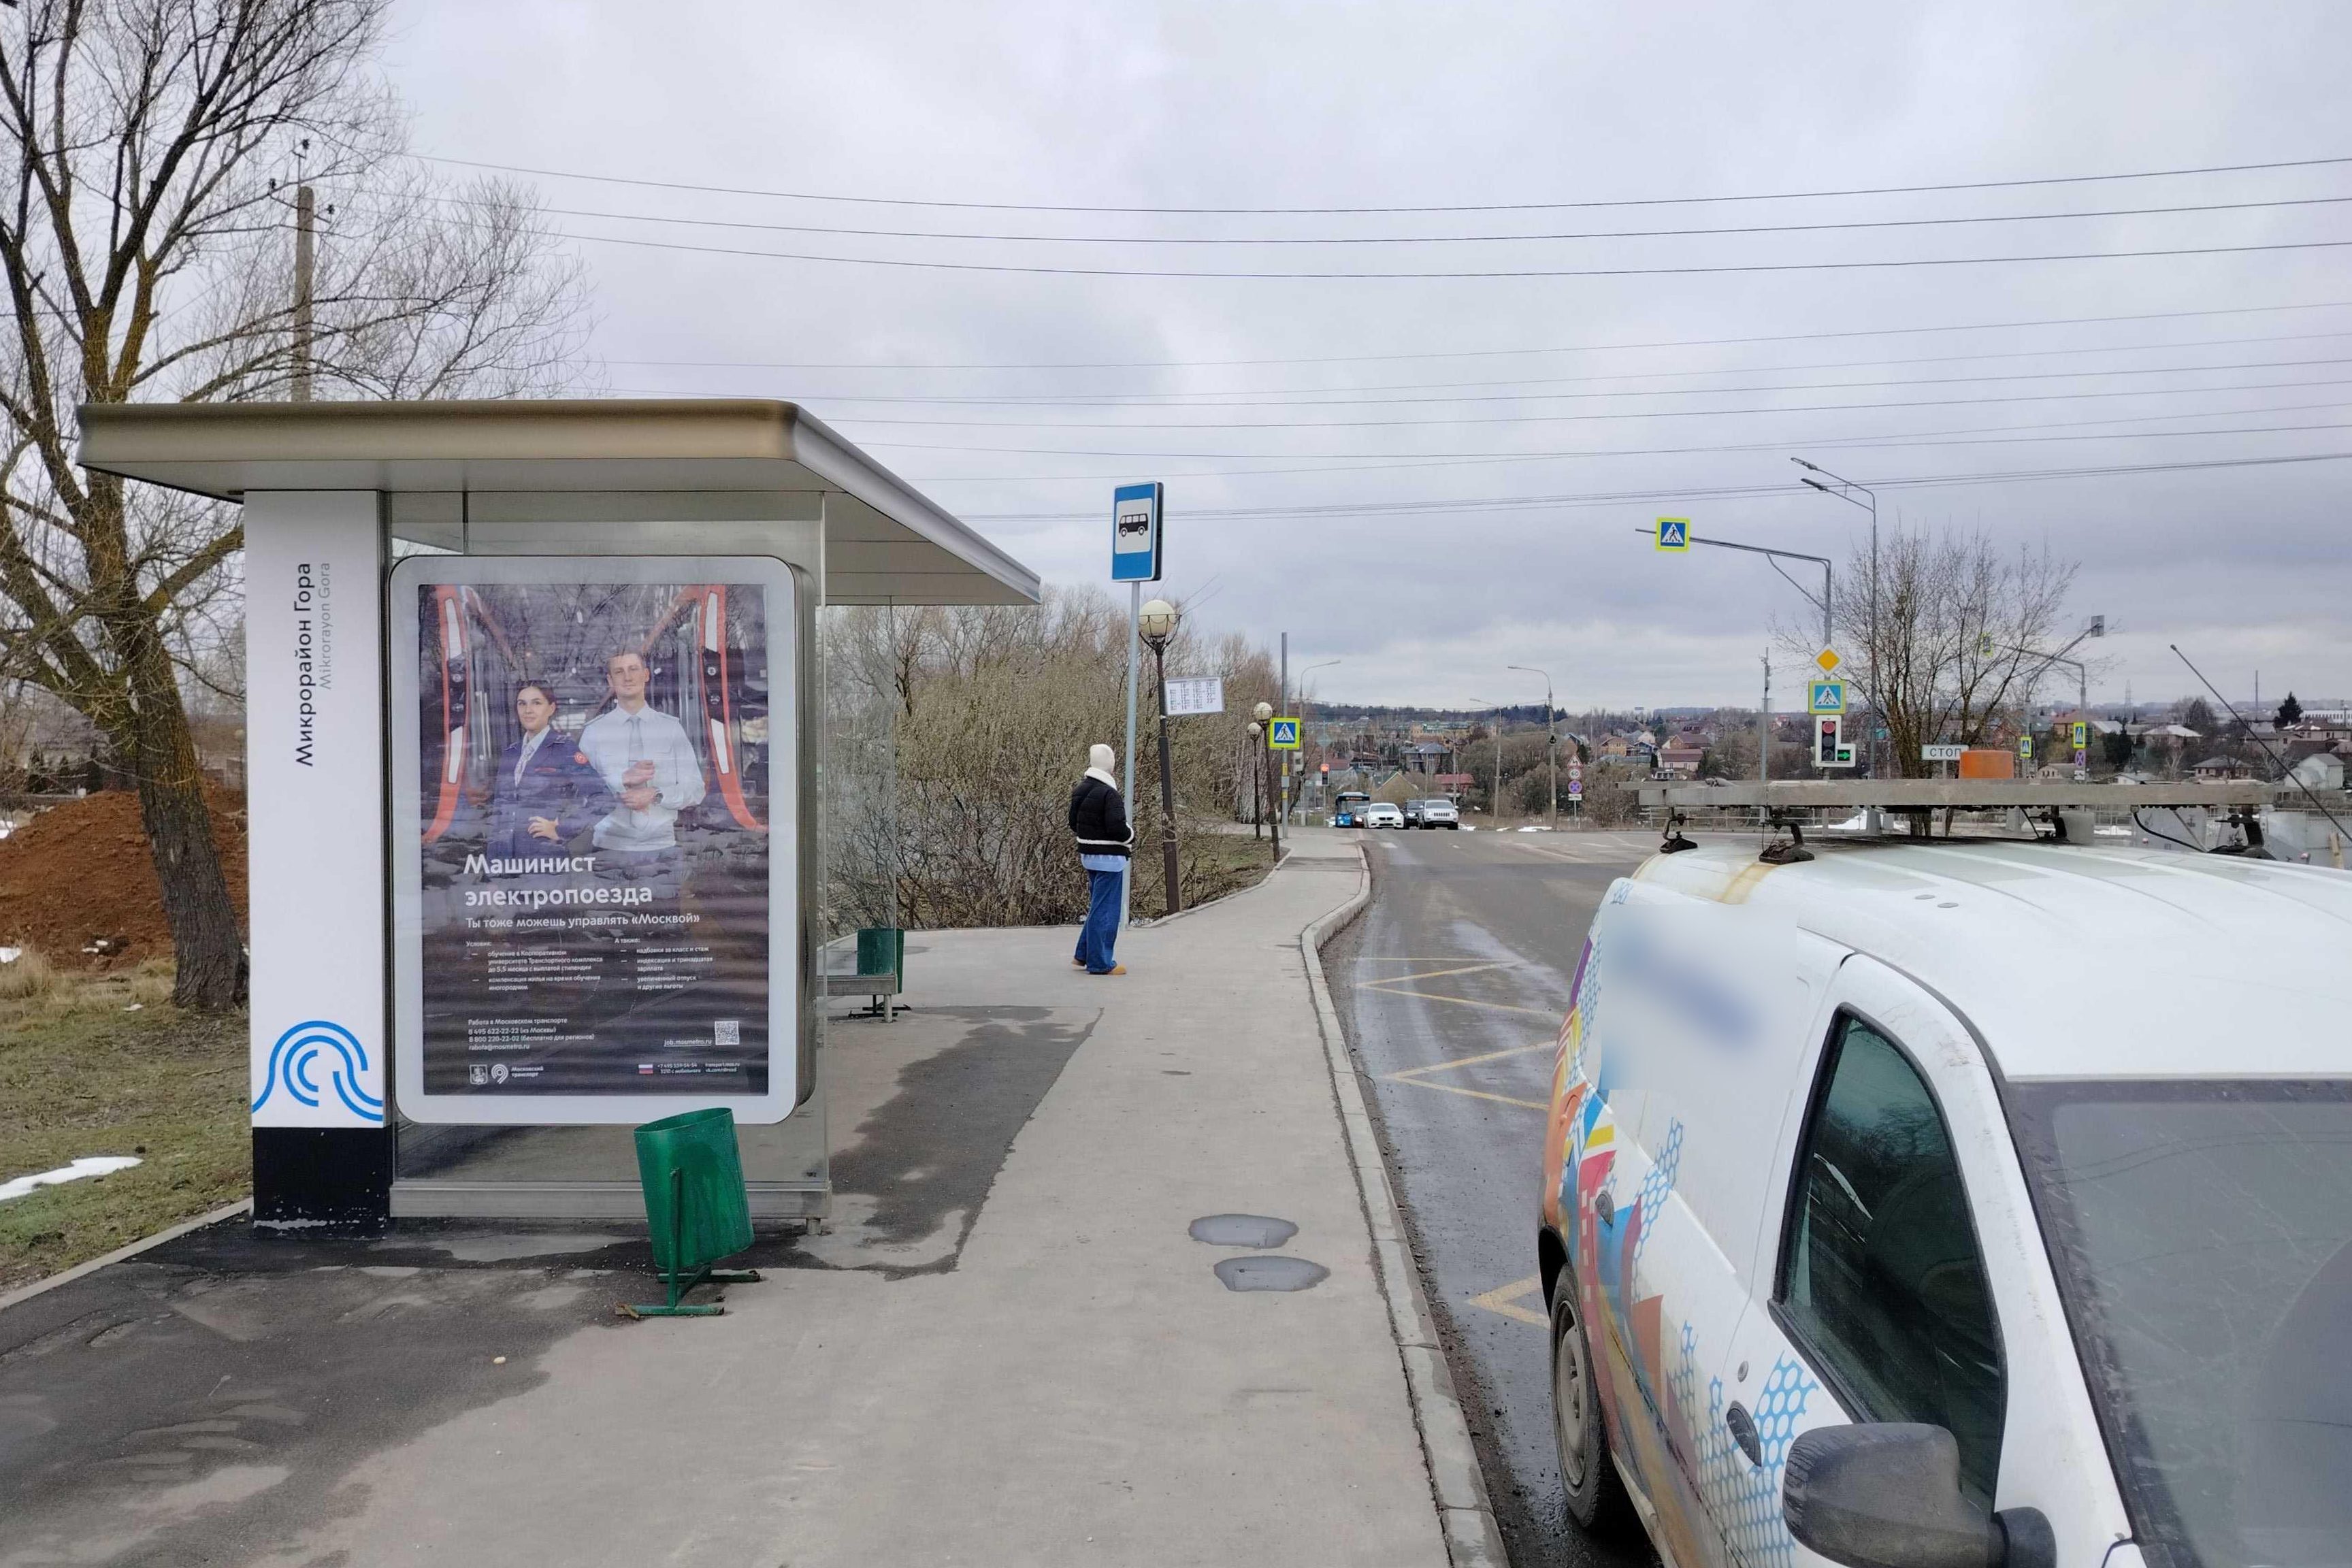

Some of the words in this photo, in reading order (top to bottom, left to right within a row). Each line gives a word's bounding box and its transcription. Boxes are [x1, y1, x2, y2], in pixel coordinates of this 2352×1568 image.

[294, 564, 315, 612] Гора
[318, 562, 331, 599] Gora
[318, 603, 333, 690] Mikrorayon
[294, 620, 316, 767] Микрорайон
[1930, 748, 1961, 757] СТОП
[463, 854, 596, 875] Машинист
[465, 887, 653, 910] электропоезда
[466, 918, 480, 928] Ты
[483, 919, 513, 928] тоже
[517, 917, 566, 928] можешь
[568, 917, 629, 929] управлять
[632, 913, 700, 926] «Москвой»
[534, 1017, 568, 1026] транспорте
[468, 1043, 530, 1051] rabota@mosmetro.ru
[520, 1034, 553, 1042] (бесплатно
